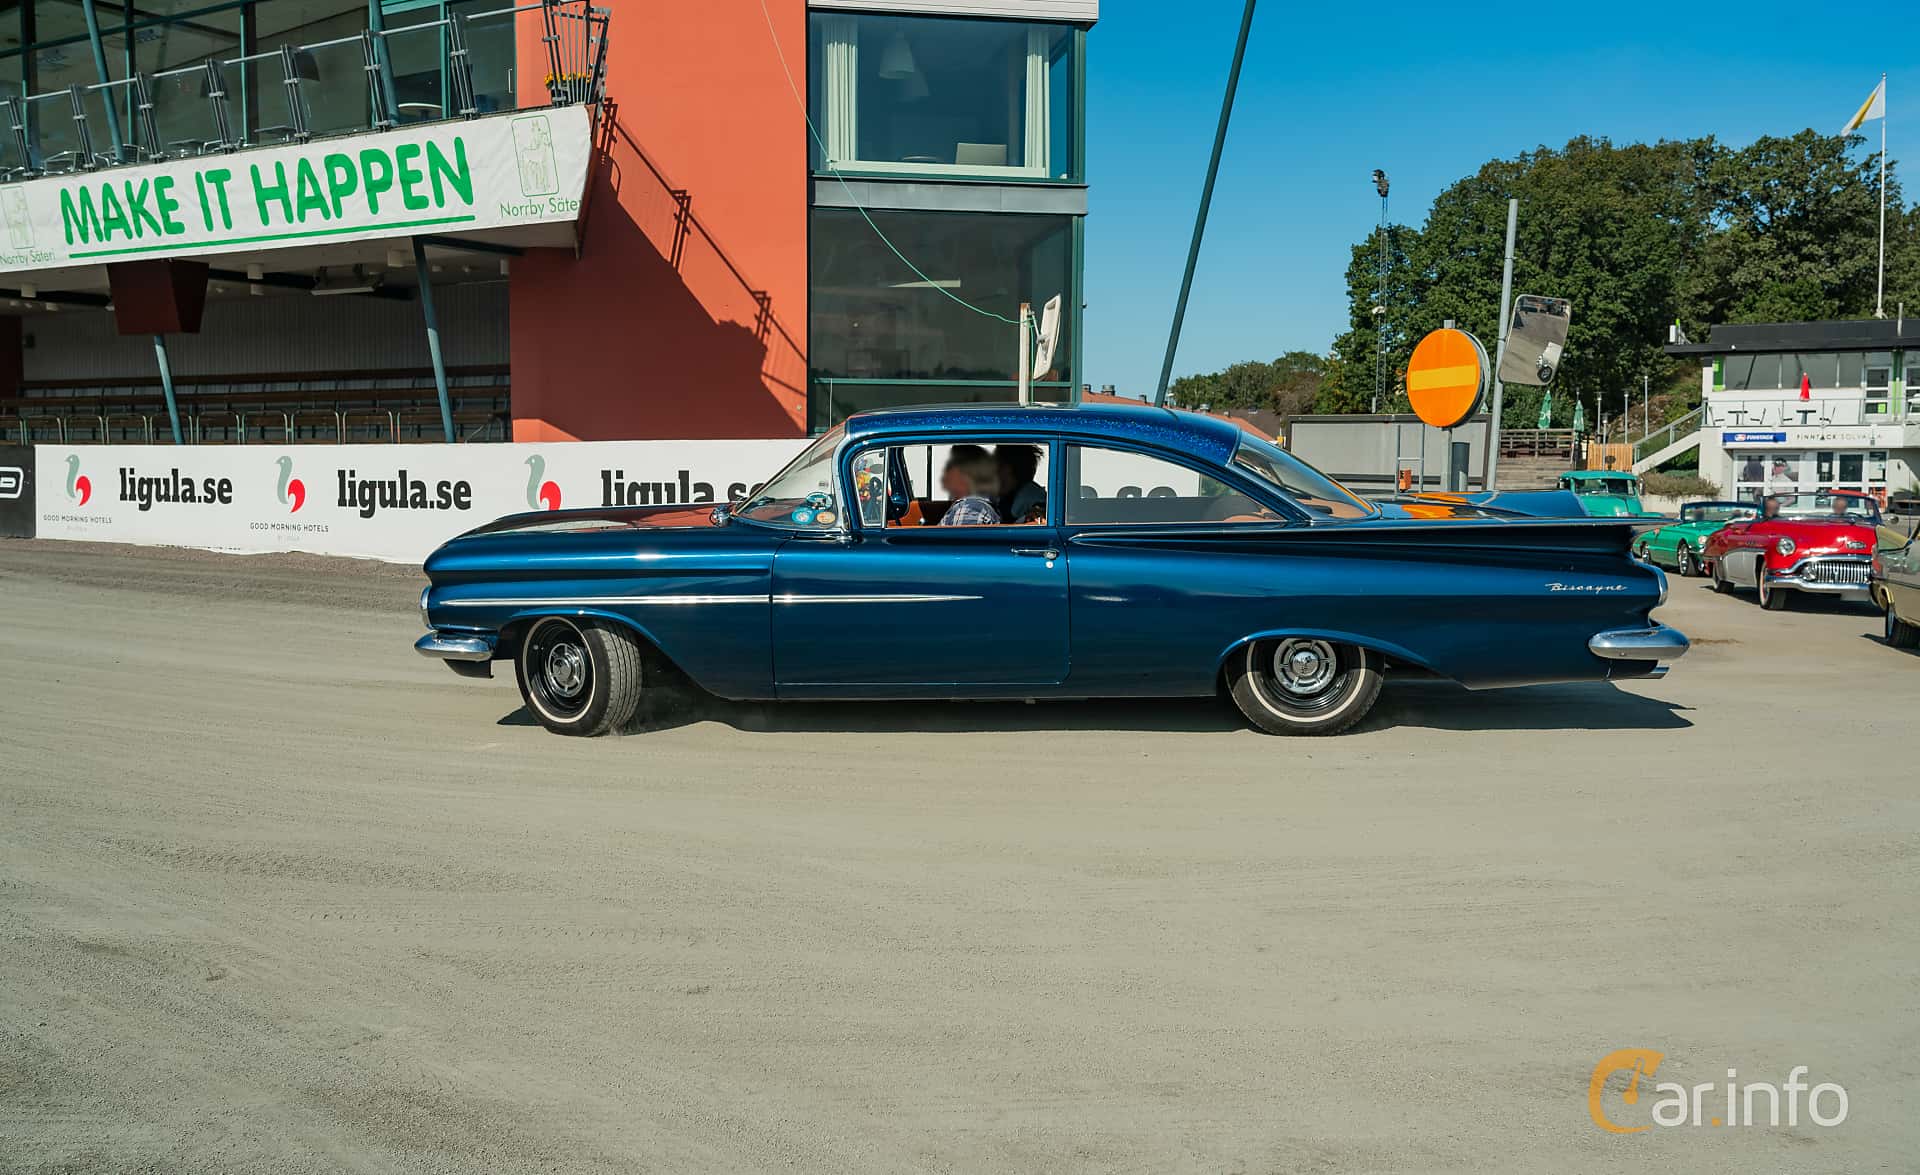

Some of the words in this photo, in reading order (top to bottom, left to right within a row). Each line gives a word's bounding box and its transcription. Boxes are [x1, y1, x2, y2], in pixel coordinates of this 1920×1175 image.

[60, 175, 185, 246] MAKE
[195, 168, 233, 231] IT
[250, 136, 474, 226] HAPPEN
[500, 199, 545, 219] Norrby
[119, 467, 233, 512] ligula.se
[337, 469, 472, 519] ligula.se
[250, 522, 269, 530] GOOD
[271, 523, 301, 532] MORNING
[303, 524, 329, 533] HOTELS
[1544, 582, 1628, 595] Biscayne
